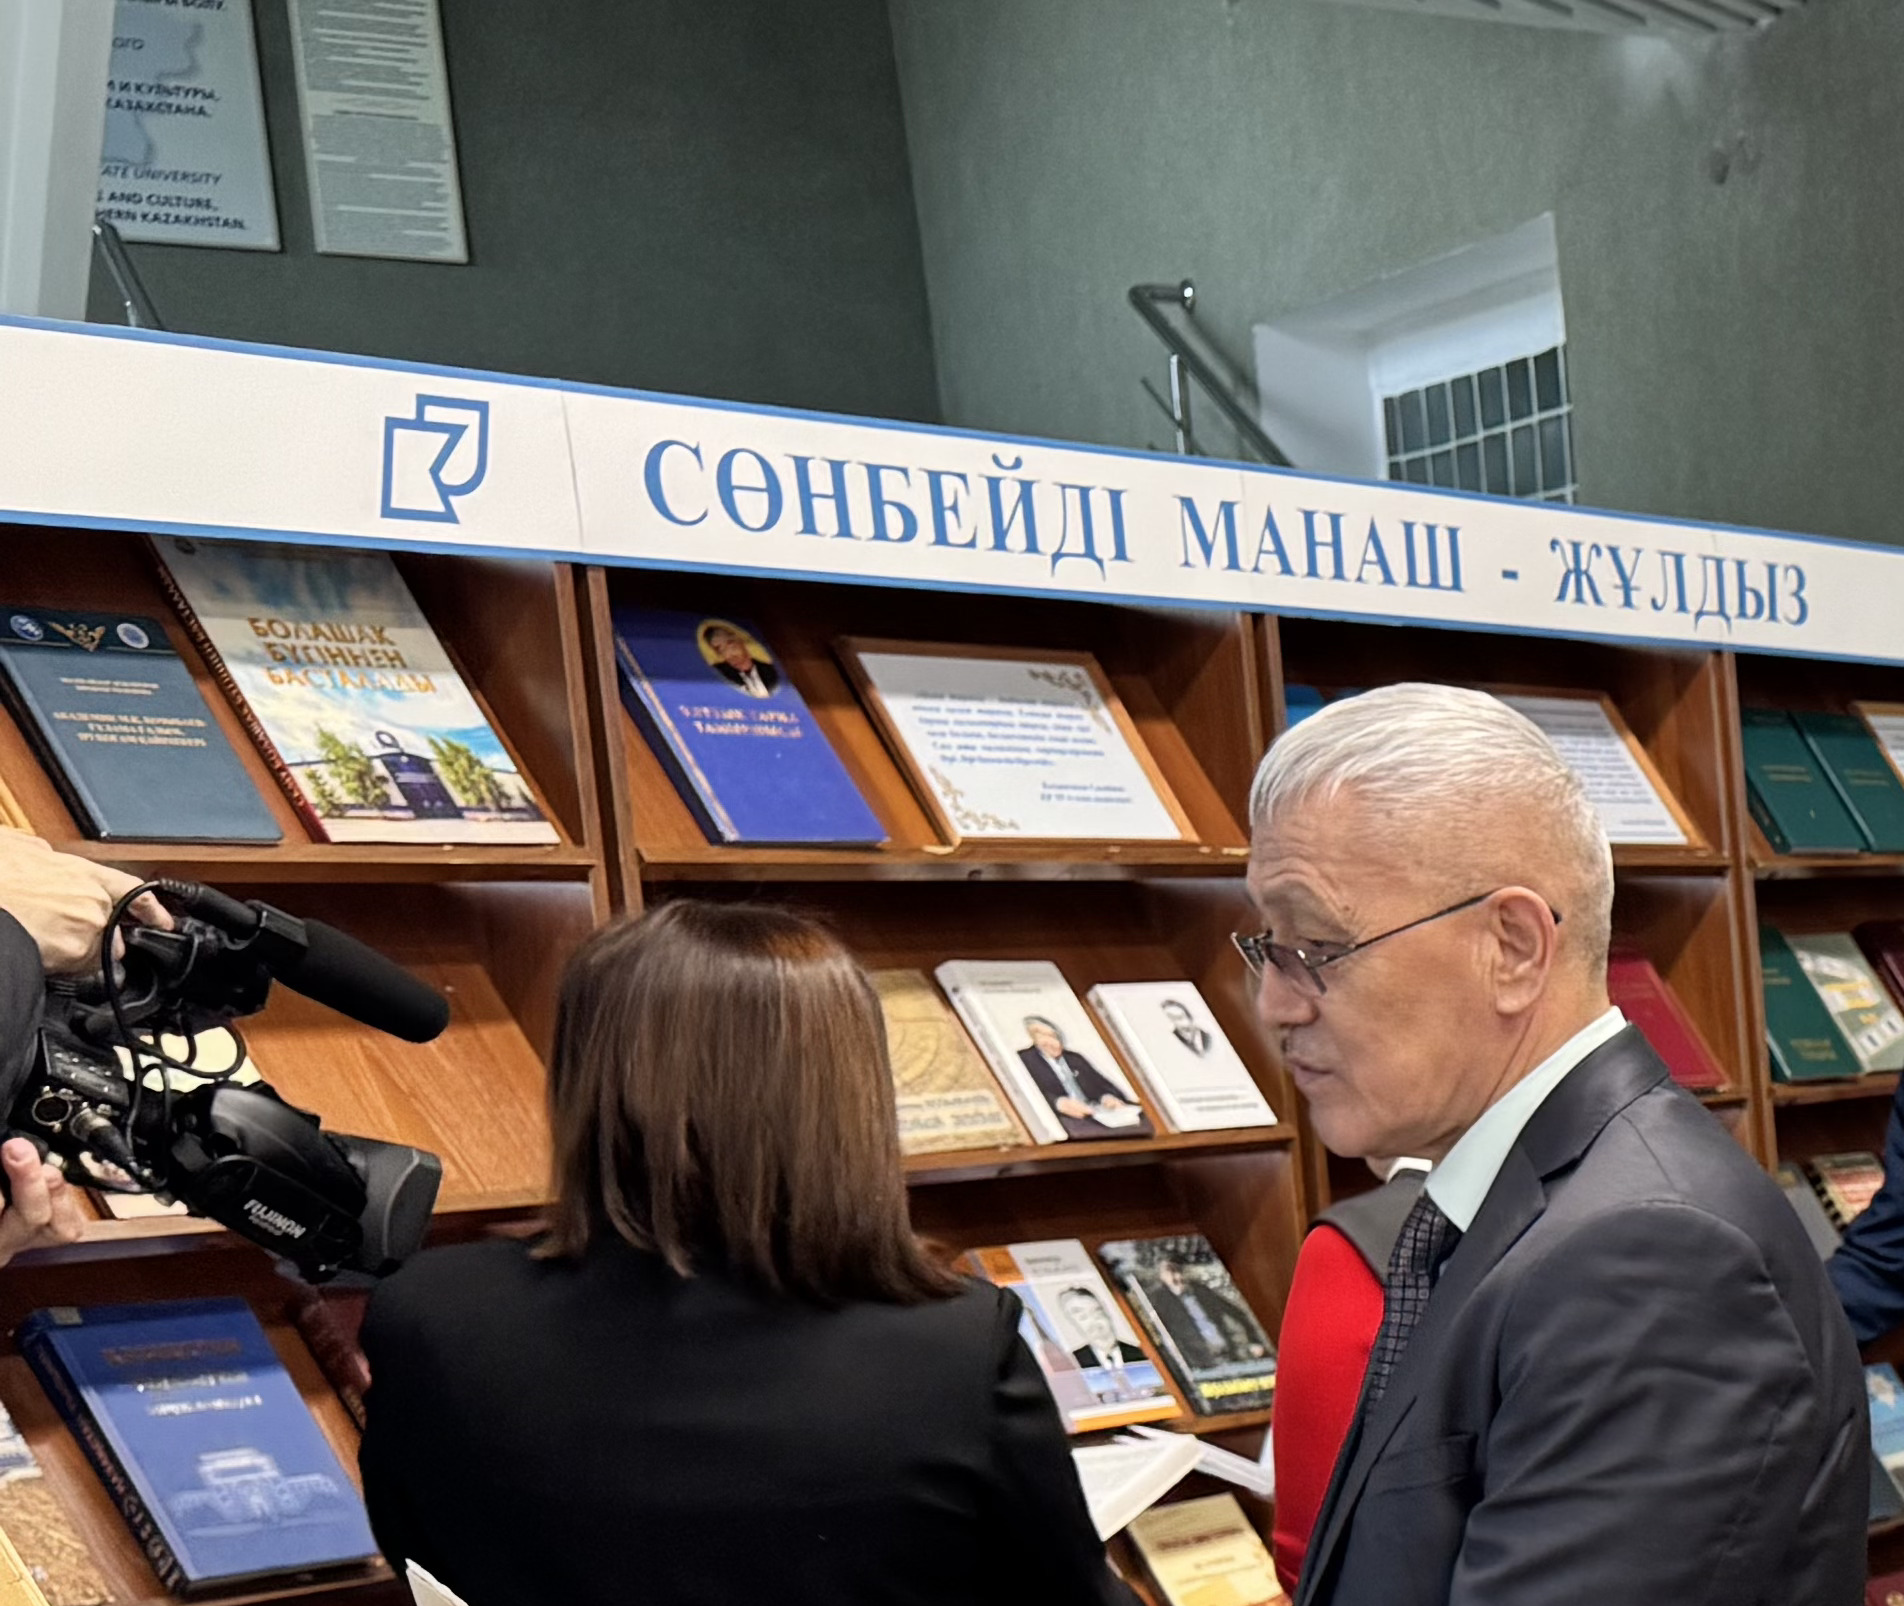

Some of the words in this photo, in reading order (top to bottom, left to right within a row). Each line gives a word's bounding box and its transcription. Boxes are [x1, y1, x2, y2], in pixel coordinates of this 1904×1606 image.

[101, 165, 129, 180] ATE
[133, 167, 222, 185] UNIVERSITY
[642, 438, 1136, 581] СӨНБЕЙДІ
[1173, 494, 1466, 594] МАНАШ
[1501, 568, 1520, 582] -
[1549, 536, 1810, 634] ЖҰЛДЫЗ
